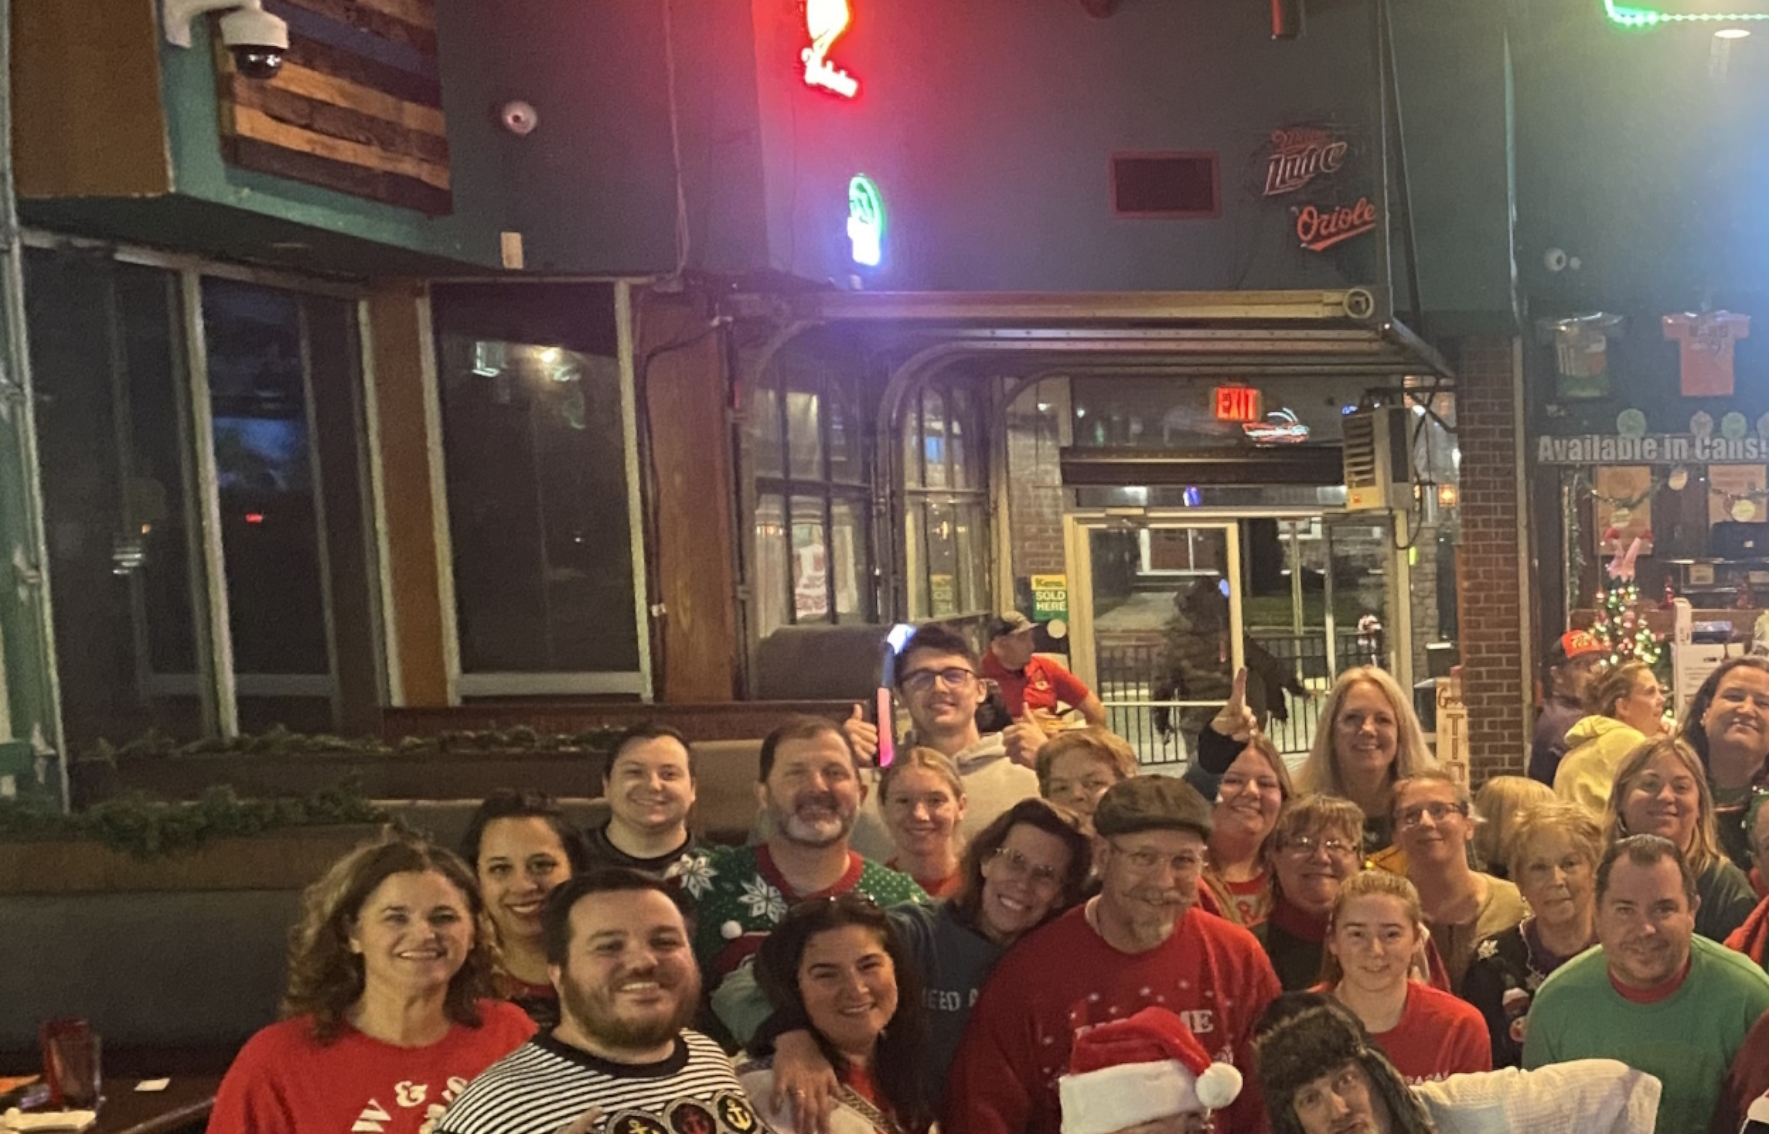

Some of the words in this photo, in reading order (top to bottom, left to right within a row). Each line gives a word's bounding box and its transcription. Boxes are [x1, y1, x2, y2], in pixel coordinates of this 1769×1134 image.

[1217, 388, 1257, 420] EXIT
[1538, 435, 1657, 462] Available
[1664, 435, 1688, 460] in
[1695, 437, 1766, 461] Cans!
[1036, 591, 1066, 601] SOLD
[1036, 601, 1067, 611] HERE
[394, 1080, 427, 1107] &
